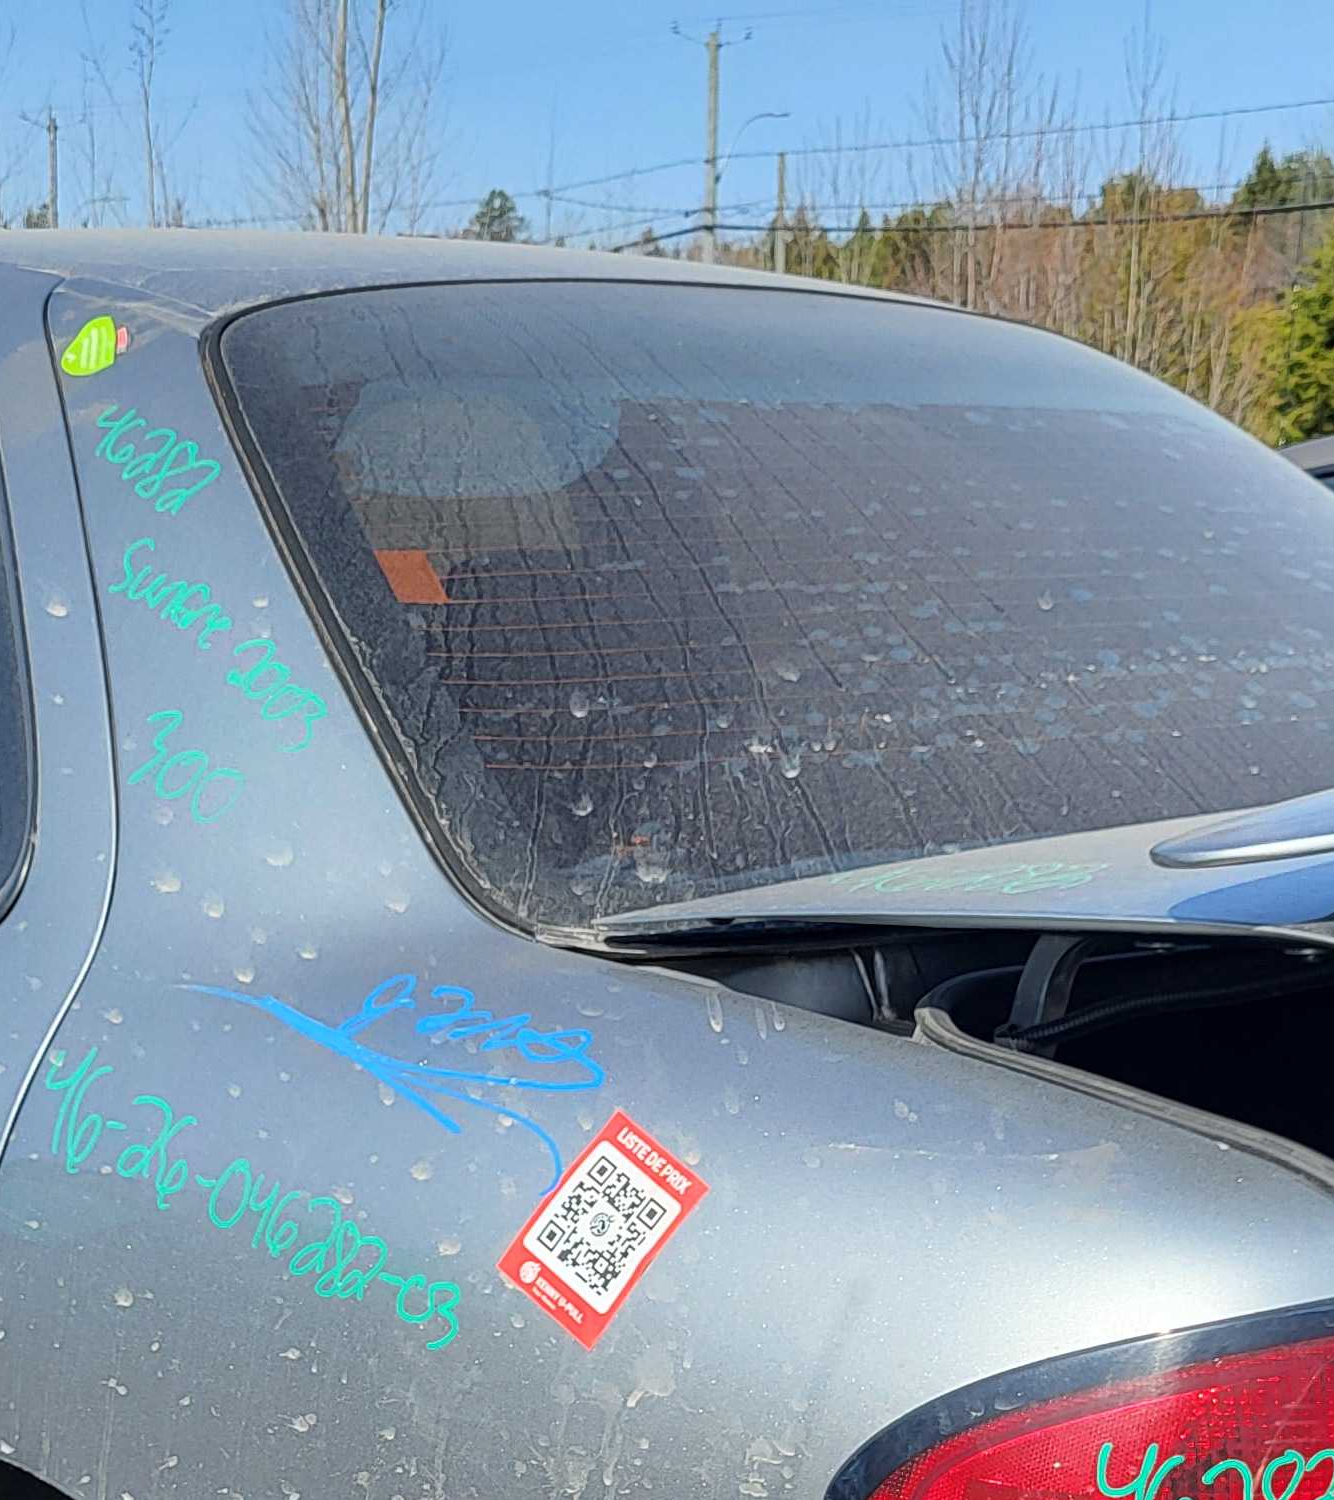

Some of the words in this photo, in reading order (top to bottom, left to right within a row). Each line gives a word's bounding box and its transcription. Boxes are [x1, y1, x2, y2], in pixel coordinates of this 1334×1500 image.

[95, 403, 222, 515] 46282
[225, 638, 329, 753] 2003
[127, 709, 247, 825] 300
[617, 1127, 646, 1161] LISTE
[645, 1151, 666, 1173] DE
[659, 1164, 693, 1195] PRIX
